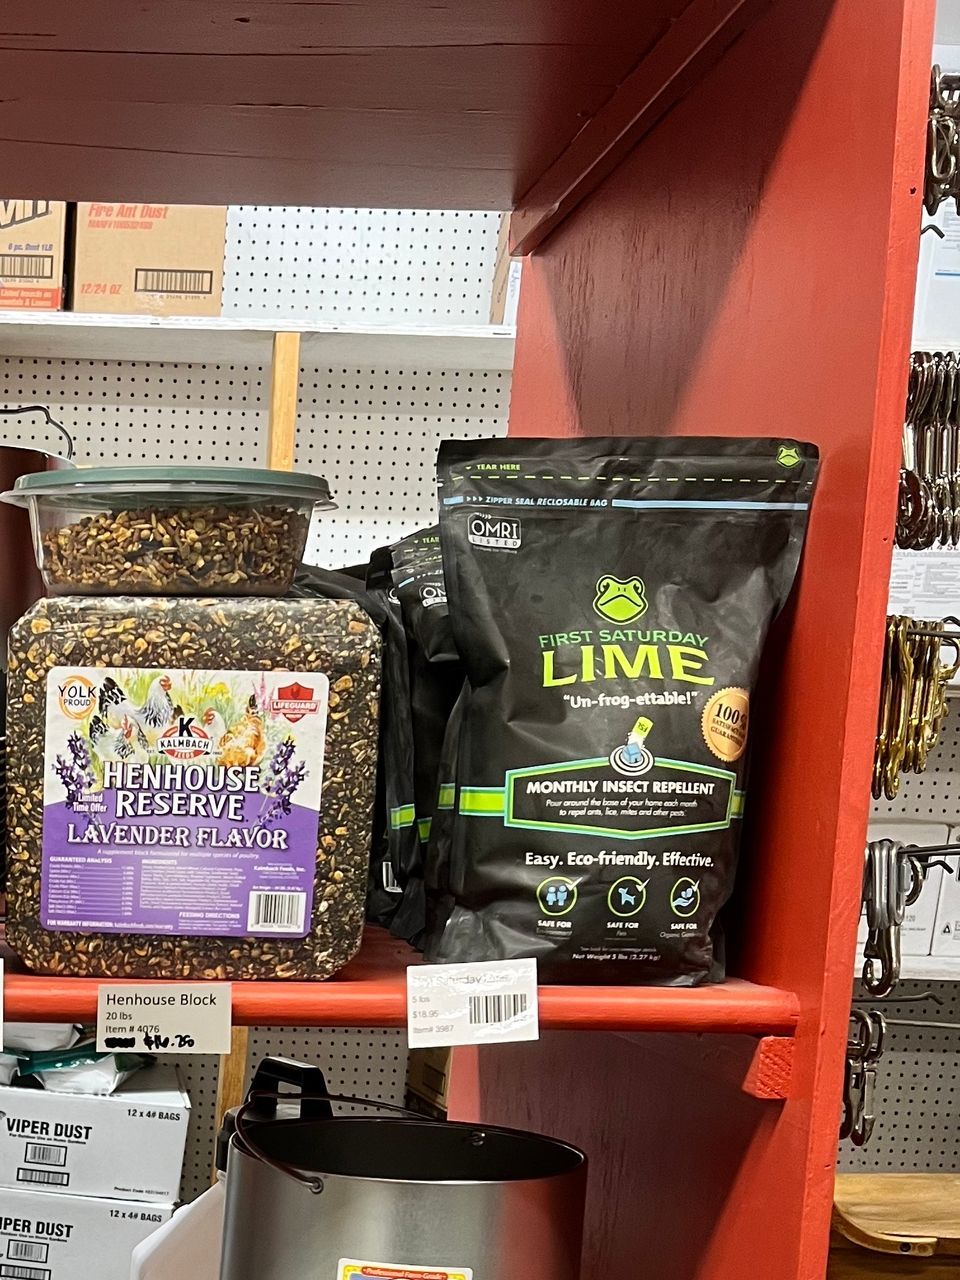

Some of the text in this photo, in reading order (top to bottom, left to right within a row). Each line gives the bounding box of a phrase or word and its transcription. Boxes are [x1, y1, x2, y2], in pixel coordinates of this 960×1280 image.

[88, 203, 168, 219] Fire Ant Dust
[80, 282, 106, 295] 12/24
[486, 496, 608, 507] ZIPPER SEAL BAG
[471, 519, 518, 538] OMRI
[472, 538, 518, 546] LISTED
[539, 630, 709, 648] FIRST SATURDAY
[542, 645, 714, 688] LIME
[58, 685, 97, 699] YOLK
[64, 699, 91, 707] PROUD
[160, 738, 210, 749] KALMBACH
[103, 761, 260, 792] HENHOUSE
[526, 780, 715, 795] MONTHLY INSECT REPELLENT
[115, 789, 245, 821] RESERVE
[563, 799, 589, 807] around
[67, 822, 289, 850] LAVENDER FLAVOR
[525, 851, 714, 869] Easy. Eco-friendly. Effective.
[106, 993, 217, 1006] Henhouse Block
[106, 1011, 133, 1020] 20 lbs
[106, 1025, 160, 1034] Item 4076
[127, 1108, 180, 1121] 12 BAGS
[6, 1117, 93, 1140] VIPER DUST
[140, 1212, 162, 1222] BAGS
[35, 1221, 74, 1238] DUST
